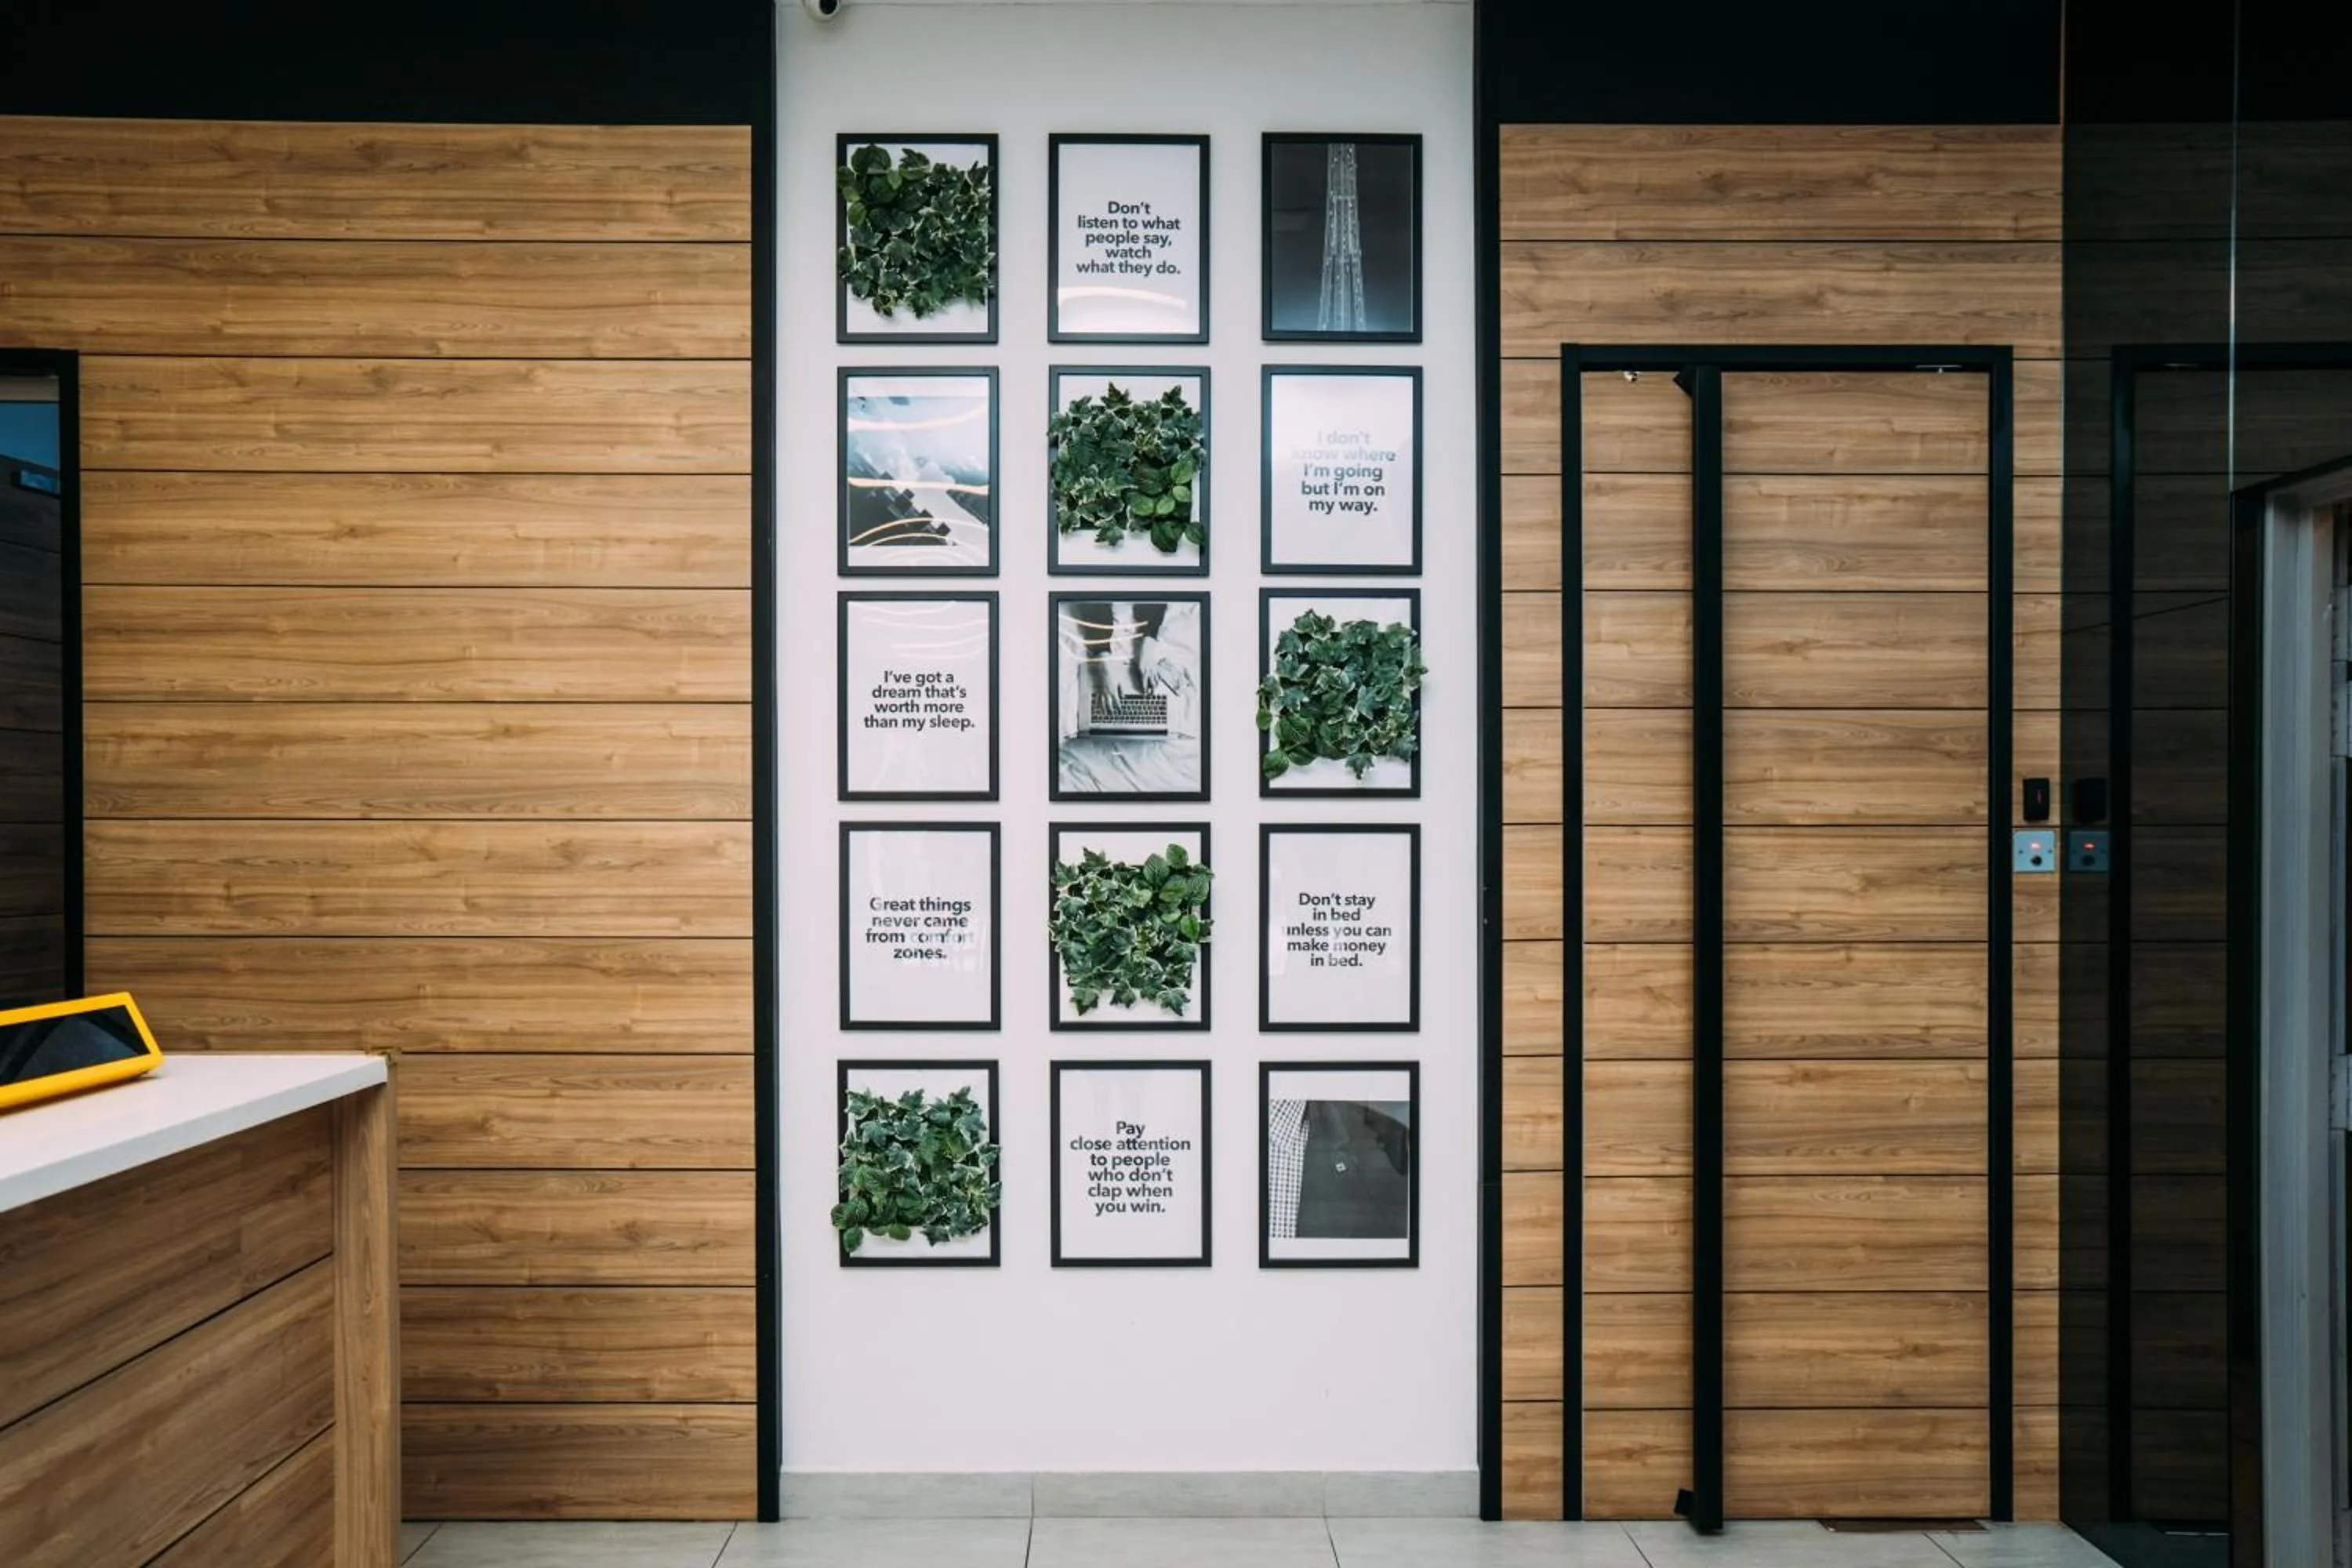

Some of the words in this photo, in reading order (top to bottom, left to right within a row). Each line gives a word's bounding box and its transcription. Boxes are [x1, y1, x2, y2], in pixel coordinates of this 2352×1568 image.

[1109, 201, 1150, 214] Don't
[1078, 216, 1118, 229] listen
[1123, 217, 1137, 229] to
[1142, 216, 1180, 230] what
[1086, 230, 1139, 246] people
[1144, 234, 1171, 248] say,
[1106, 246, 1151, 258] watch
[1077, 260, 1114, 273] what
[1119, 261, 1152, 277] they
[1156, 261, 1180, 274] do.
[1317, 430, 1322, 443] I
[1327, 430, 1370, 444] don't
[1345, 448, 1396, 461] where
[1304, 464, 1329, 476] I'm
[1334, 464, 1383, 481] going
[1301, 481, 1329, 495] but
[1334, 481, 1359, 495] I'm
[1364, 485, 1385, 495] on
[1309, 501, 1334, 514] my
[1340, 501, 1377, 515] way.
[884, 671, 911, 682] I've
[916, 673, 941, 687] got
[872, 685, 920, 698] dream
[925, 685, 967, 698] that's
[875, 700, 919, 713] worth
[924, 703, 964, 713] more
[864, 715, 898, 728] than
[902, 718, 925, 731] my
[930, 715, 975, 731] sleep.
[869, 897, 916, 911] Great
[919, 897, 971, 914] things
[1299, 893, 1341, 905] Don't
[1345, 895, 1375, 909] stay
[1313, 908, 1326, 920] in
[1331, 908, 1360, 920] bed
[873, 916, 920, 927] never
[924, 916, 968, 927] came
[866, 928, 905, 942] from
[1334, 926, 1362, 938] you
[1366, 927, 1392, 936] can
[894, 948, 946, 959] zones.
[1287, 938, 1329, 951] make
[1333, 942, 1386, 955] money
[1311, 954, 1323, 967] in
[1329, 953, 1363, 967] bed.
[1116, 1121, 1145, 1138] Pay
[1070, 1136, 1111, 1150] close
[1116, 1138, 1190, 1150] attention
[1091, 1154, 1107, 1166] to
[1112, 1152, 1170, 1169] people
[1088, 1168, 1124, 1181] who
[1129, 1168, 1173, 1181] don't
[1088, 1184, 1122, 1200] clap
[1127, 1184, 1172, 1197] when
[1096, 1202, 1126, 1217] you
[1131, 1200, 1166, 1213] win.
